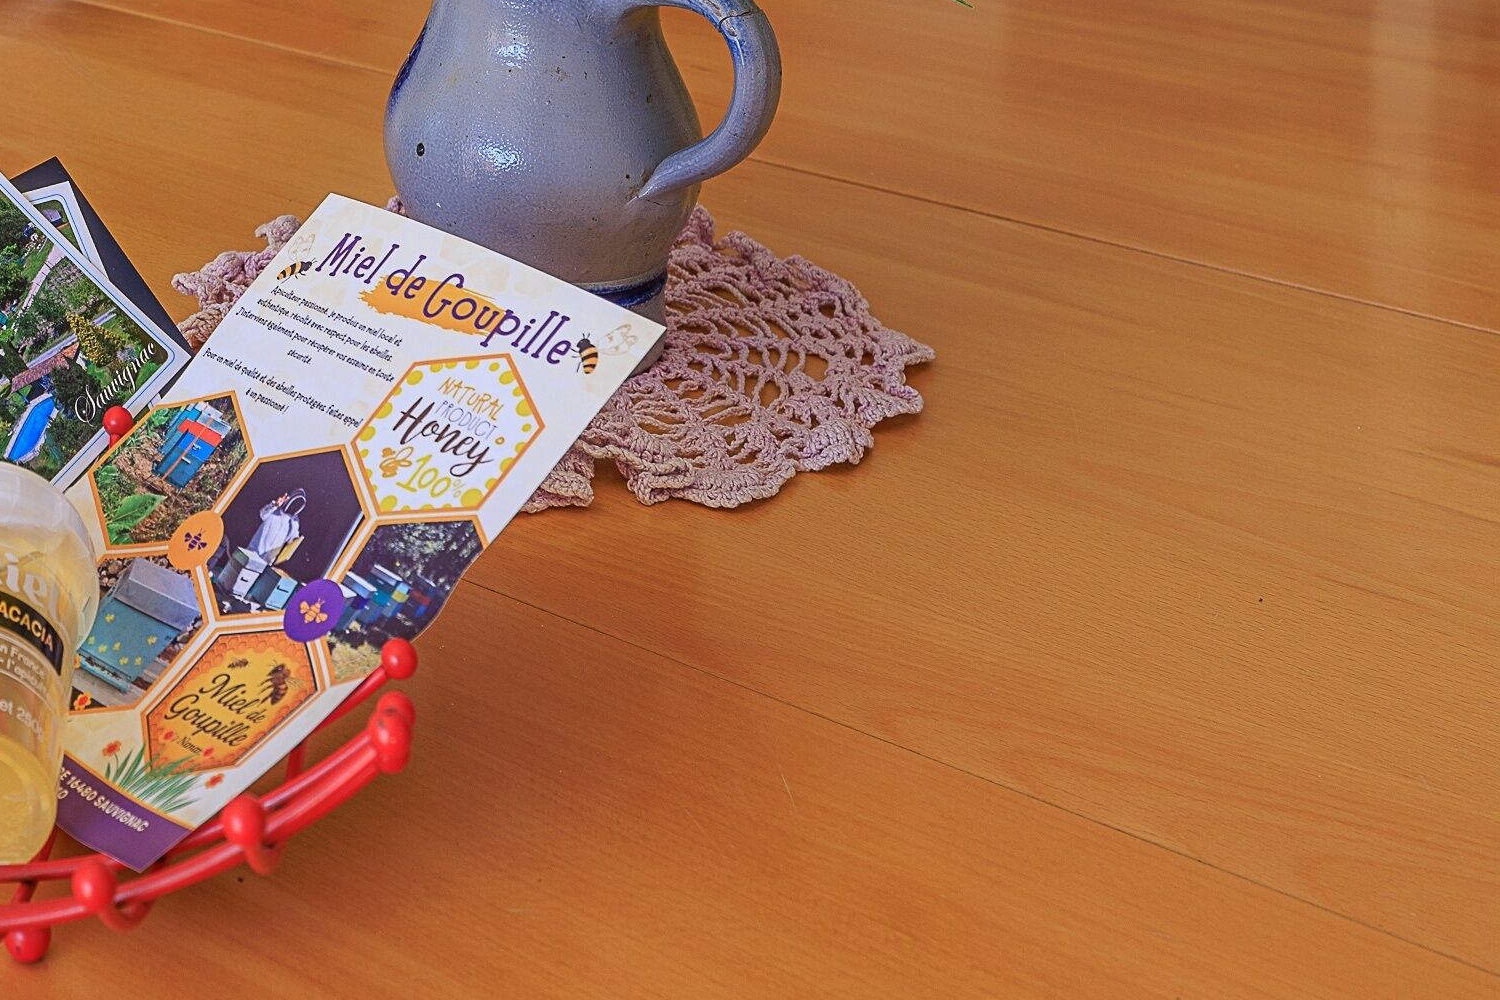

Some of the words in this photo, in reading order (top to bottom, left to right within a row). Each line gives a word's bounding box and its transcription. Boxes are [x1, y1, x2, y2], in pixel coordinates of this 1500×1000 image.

[271, 285, 301, 303] Apiculteur
[327, 309, 336, 318] je
[333, 312, 359, 328] produis
[358, 323, 367, 331] un
[365, 327, 382, 338] miel
[379, 329, 398, 344] local
[393, 339, 403, 347] et
[315, 233, 400, 284] Miel
[385, 254, 427, 300] de
[422, 273, 572, 365] Goupille
[291, 332, 308, 343] pour
[336, 352, 348, 361] vos
[368, 366, 376, 375] en
[375, 368, 395, 383] toute
[310, 321, 325, 332] avec
[323, 326, 348, 342] respect
[344, 336, 361, 348] pour
[360, 340, 371, 352] les
[75, 342, 156, 427] Sauvignac
[202, 347, 218, 360] Pour
[216, 355, 224, 364] un
[222, 358, 238, 369] miel
[234, 361, 243, 371] de
[259, 374, 268, 384] et
[266, 376, 278, 388] des
[275, 381, 298, 398] abeilles
[326, 404, 345, 420] faites
[343, 415, 364, 428] appel
[249, 391, 258, 400] un
[438, 376, 505, 421] NATURAL
[392, 396, 495, 478] Honey
[434, 400, 498, 440] PRODUCT
[164, 694, 250, 747] Goupille
[199, 673, 260, 715] Miel
[245, 708, 267, 724] de
[67, 776, 98, 801] 16480
[93, 795, 149, 832] SAUVIGNAC
